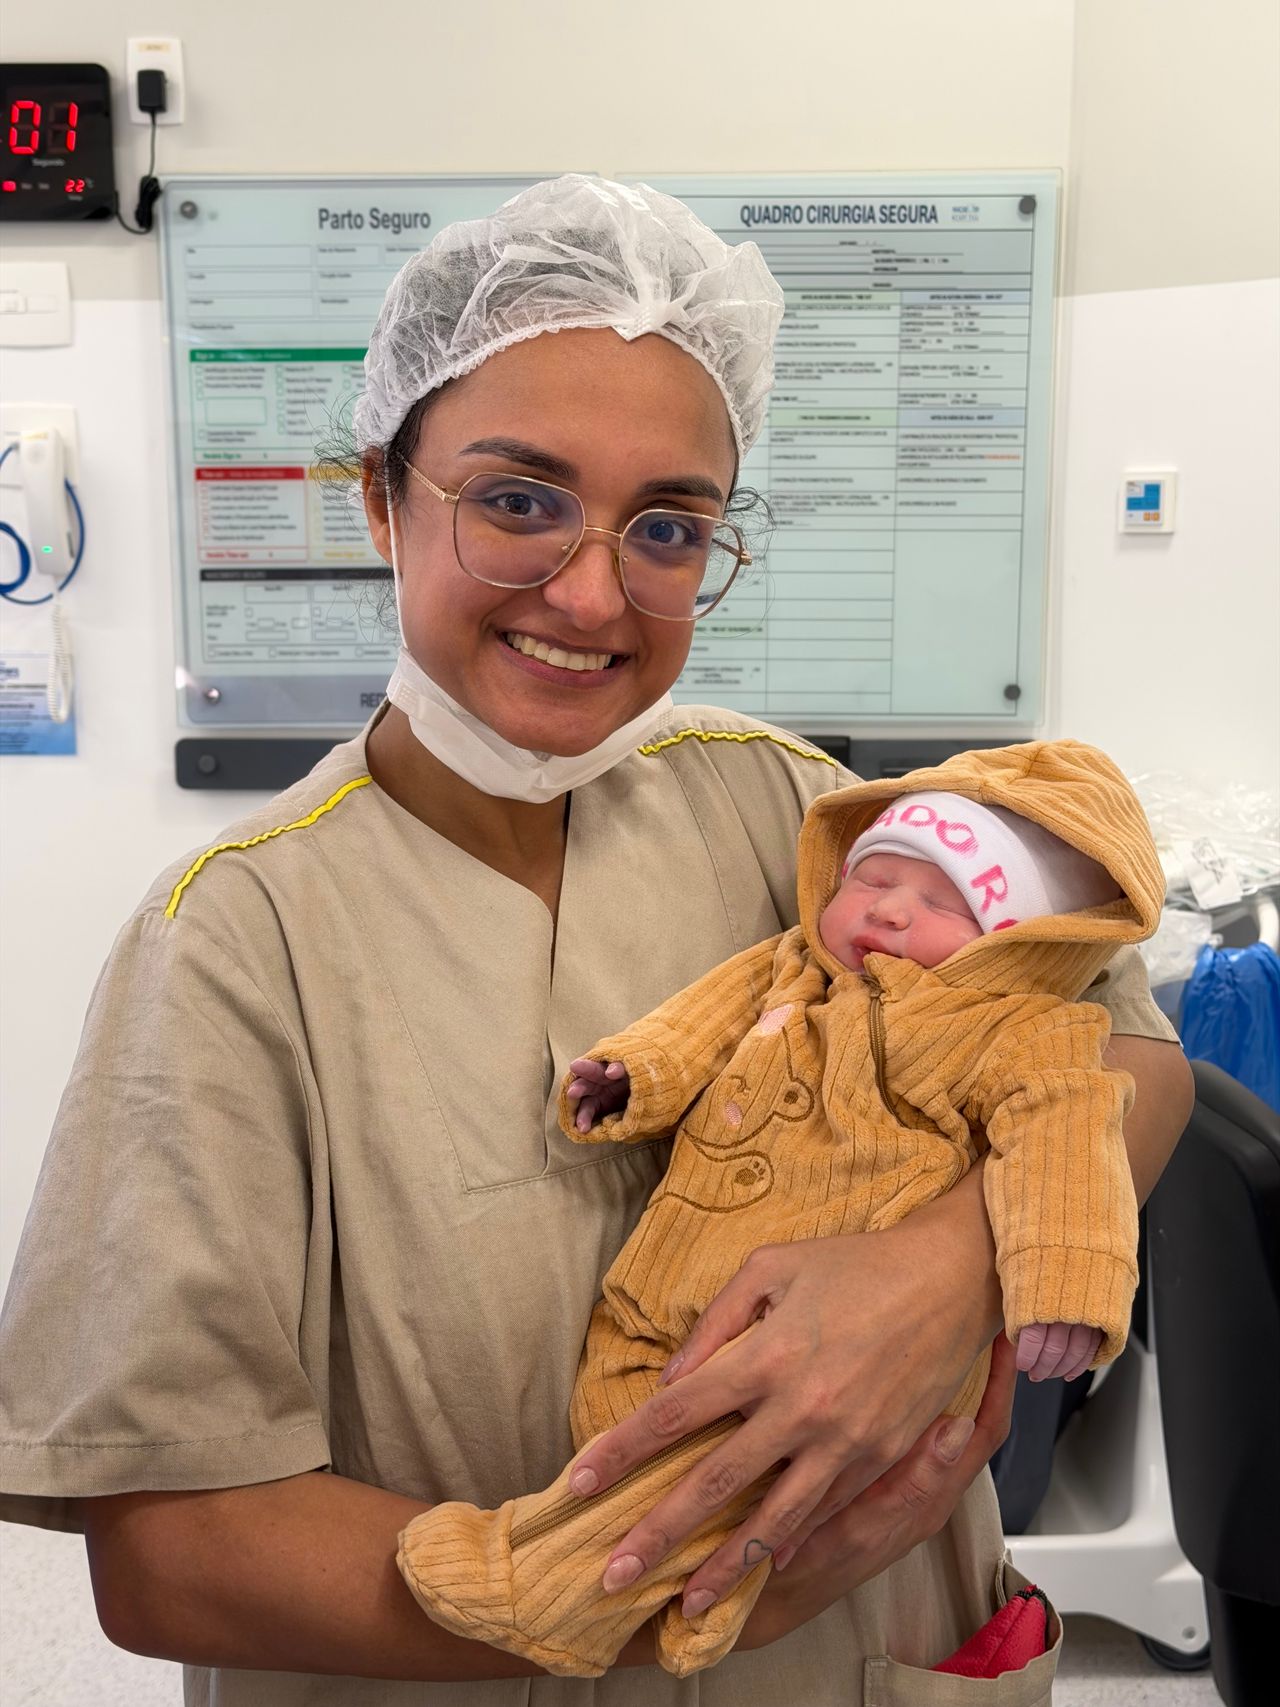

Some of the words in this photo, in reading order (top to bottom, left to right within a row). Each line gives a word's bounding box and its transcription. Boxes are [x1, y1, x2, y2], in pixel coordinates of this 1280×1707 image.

[9, 100, 79, 155] 01
[64, 179, 85, 193] 22
[318, 208, 364, 230] Parto
[369, 207, 431, 235] Seguro
[740, 205, 803, 227] QUADRO
[806, 205, 876, 224] CIRURGIA
[878, 205, 938, 224] SEGURA
